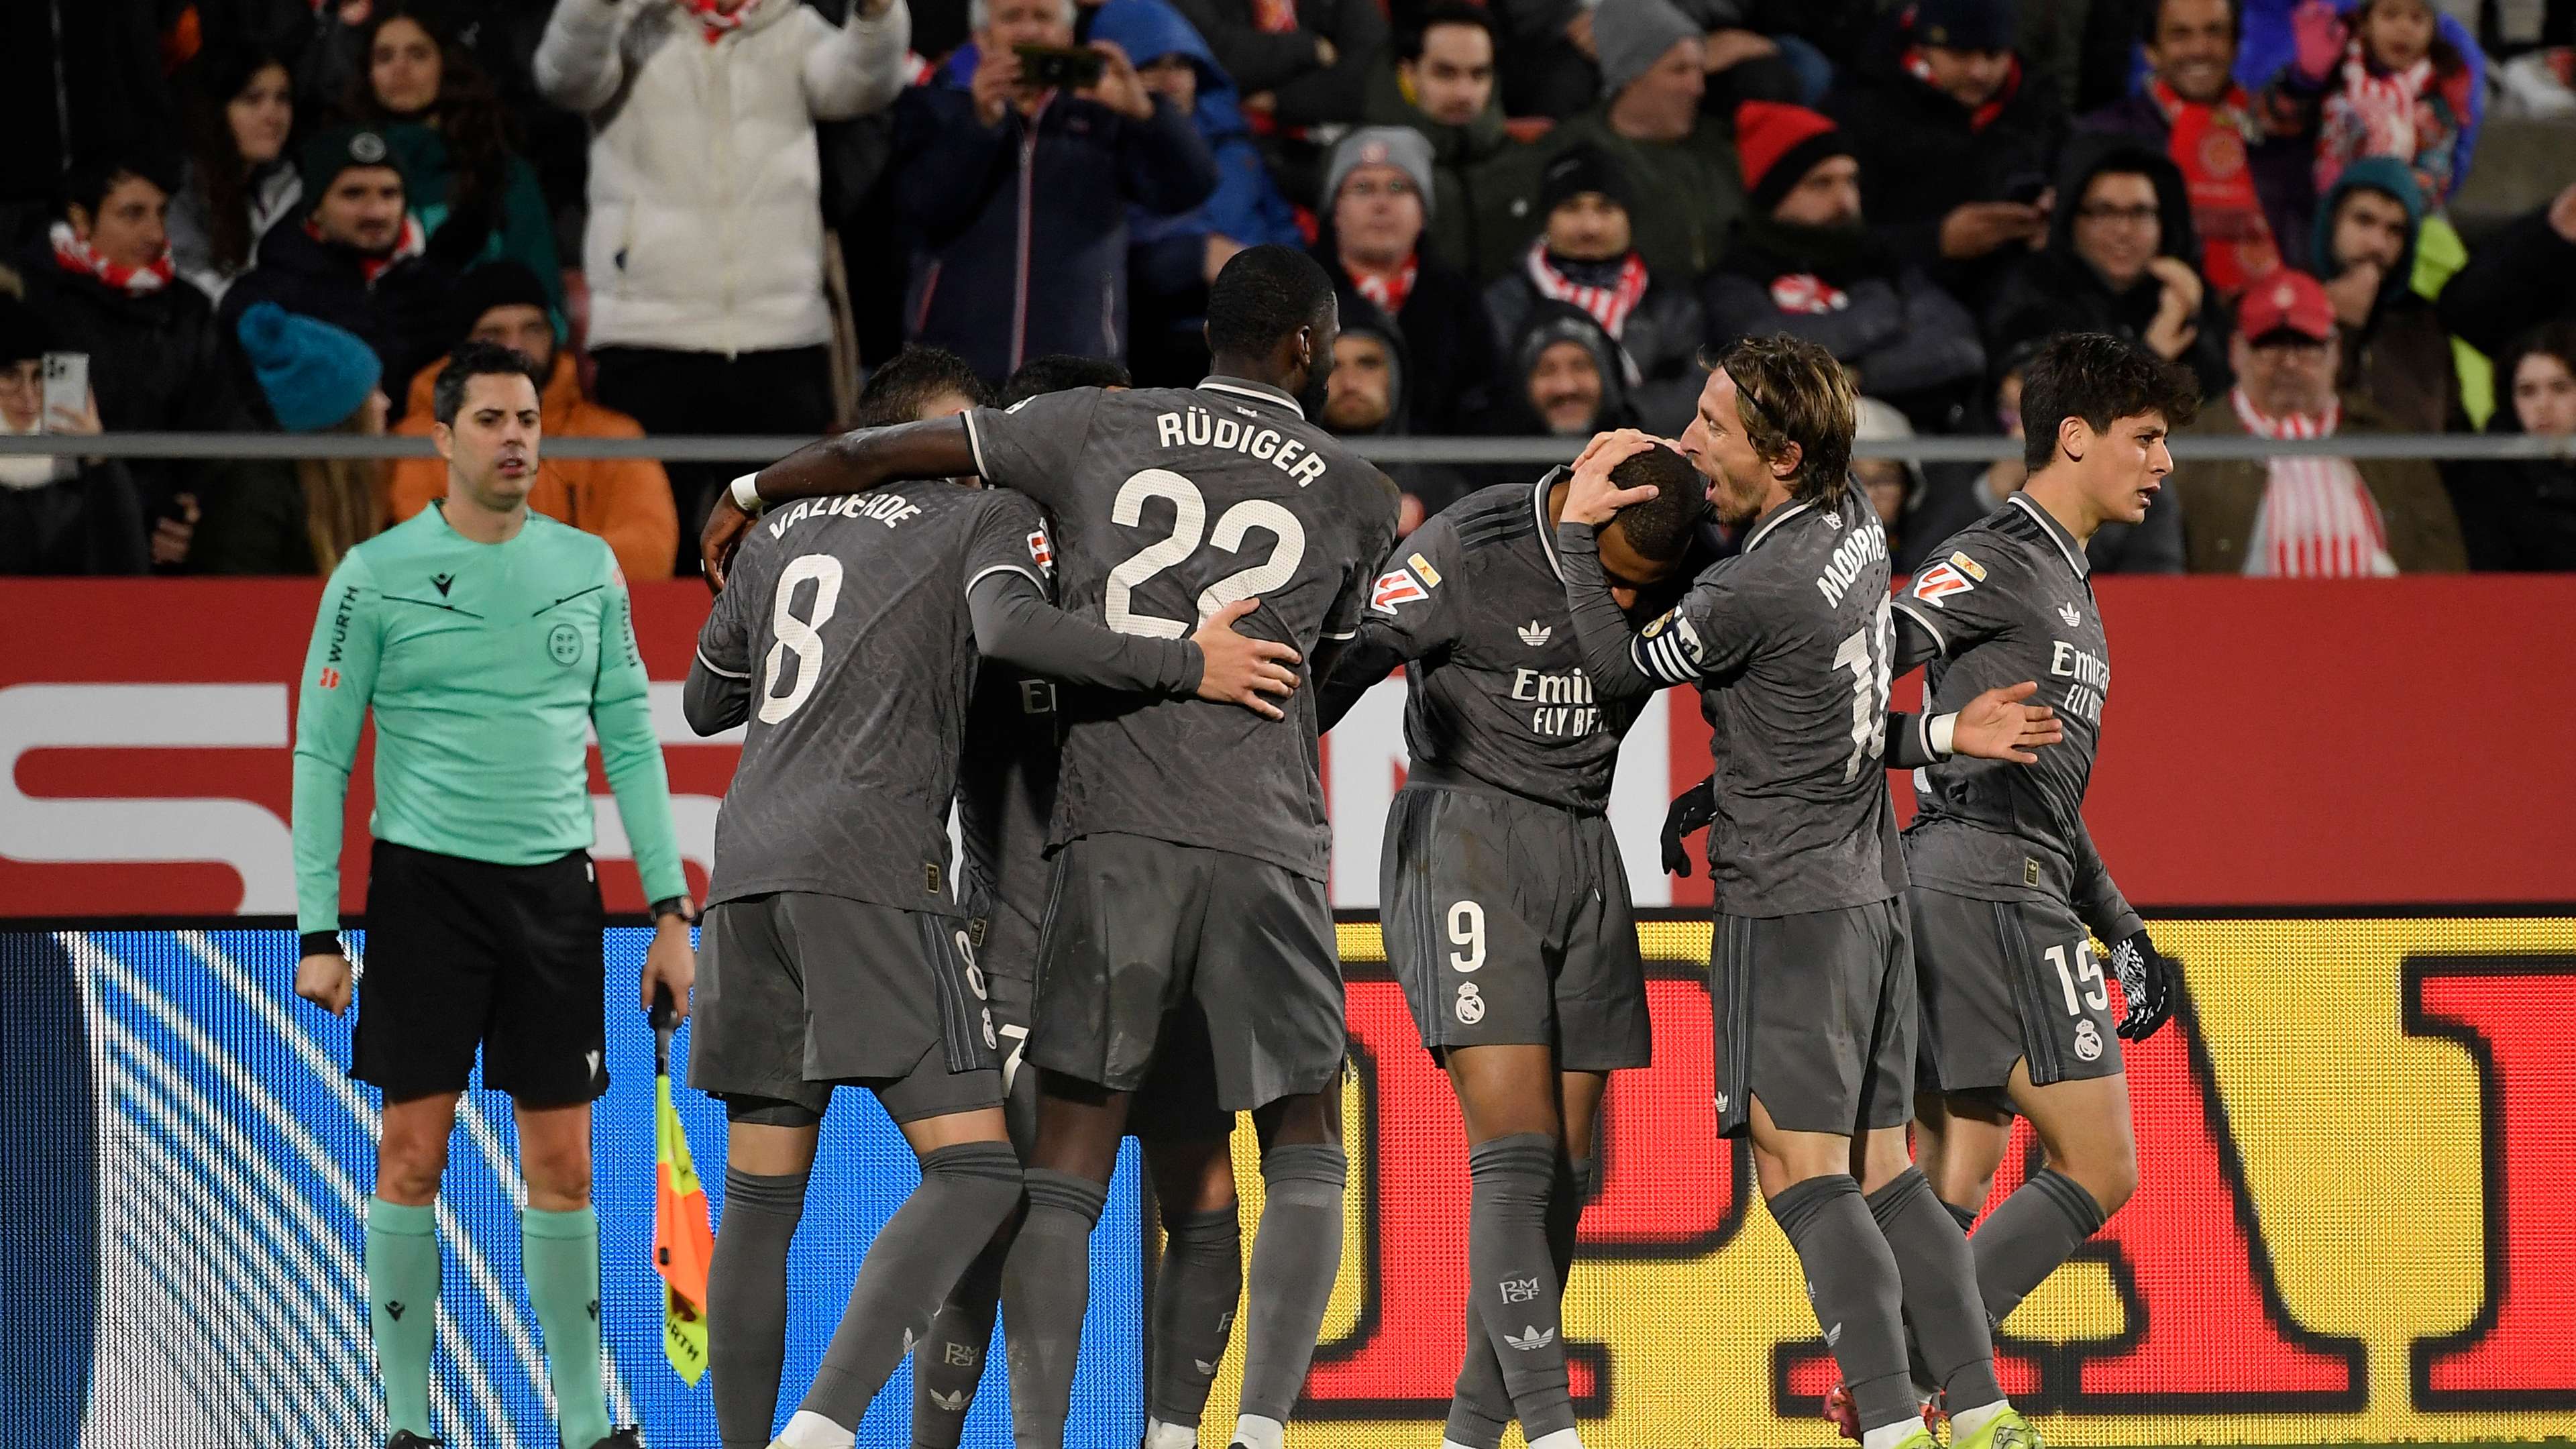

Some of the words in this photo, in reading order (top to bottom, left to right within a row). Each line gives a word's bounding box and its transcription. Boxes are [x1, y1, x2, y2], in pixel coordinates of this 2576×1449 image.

[1157, 405, 1326, 488] RÜDIGER
[769, 493, 922, 539] VALVERDE
[1105, 468, 1305, 639] 22
[1817, 516, 1886, 609] MODRIĆ
[758, 553, 844, 724] 8
[2051, 640, 2109, 694] Emira
[1534, 707, 1568, 736] FLY
[955, 930, 987, 1000] 8
[1448, 900, 1487, 973] 9
[2044, 939, 2108, 1016] 15
[999, 1024, 1029, 1098] 7
